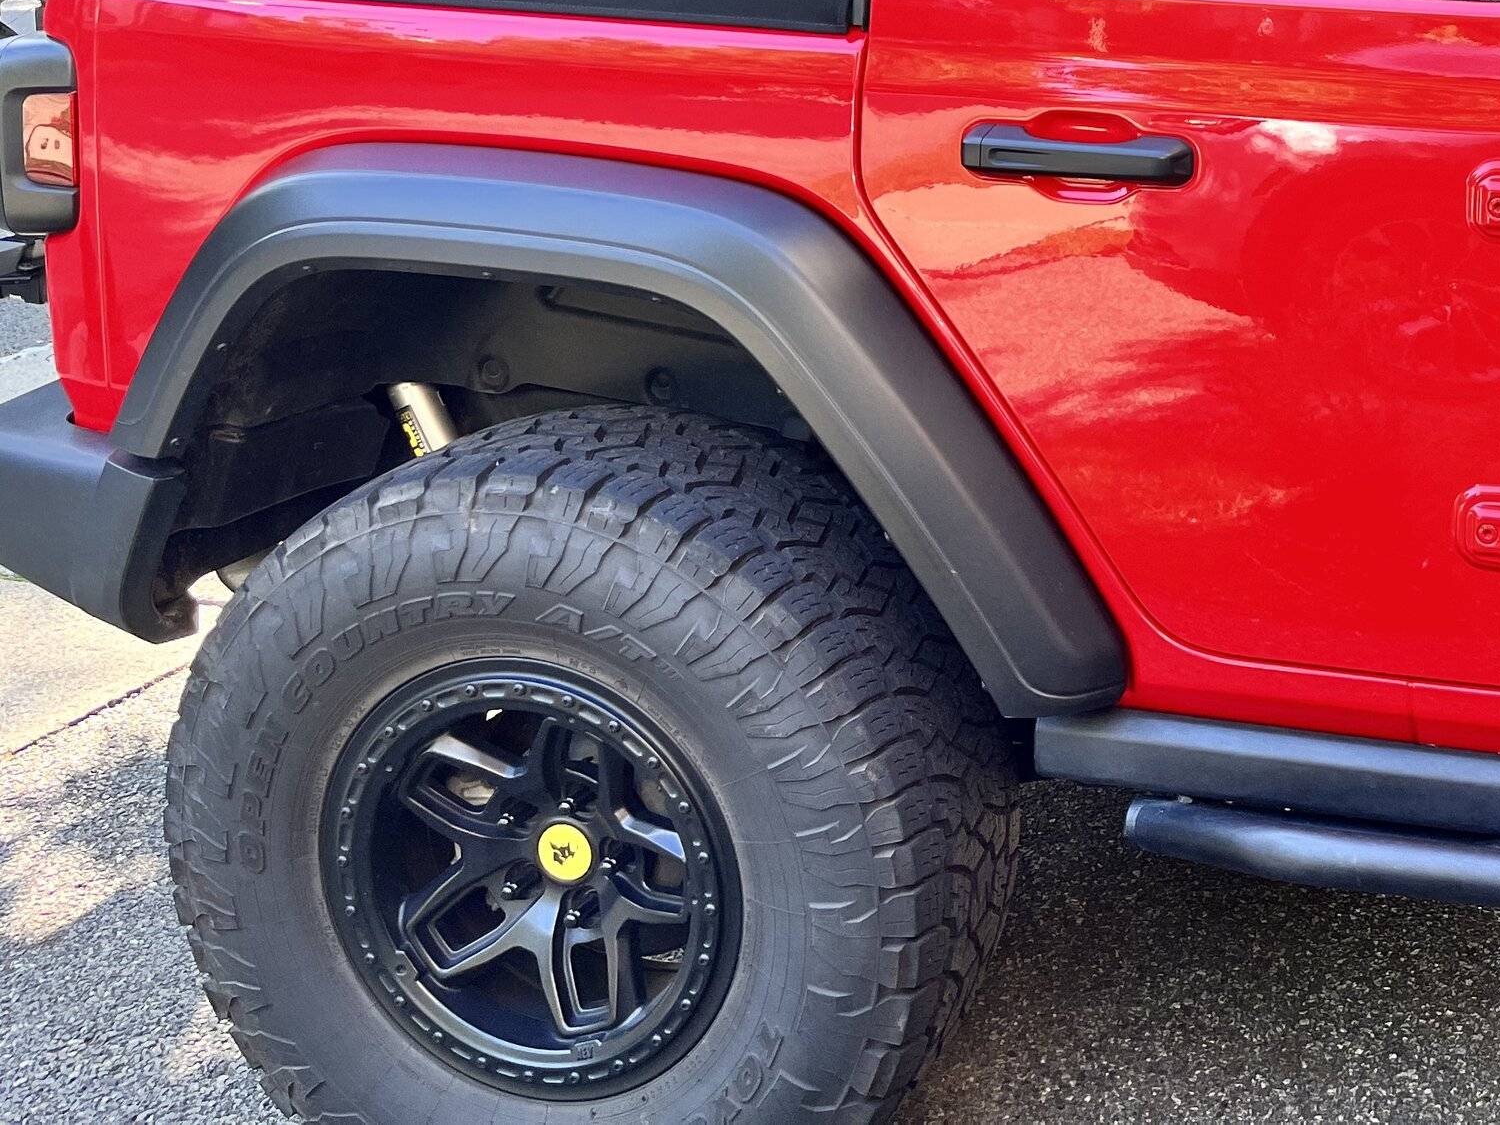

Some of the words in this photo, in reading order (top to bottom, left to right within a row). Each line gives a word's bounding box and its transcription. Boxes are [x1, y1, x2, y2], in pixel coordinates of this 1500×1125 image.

[237, 712, 289, 875] OPEN
[281, 591, 516, 714] COUNTRY
[686, 1015, 785, 1125] TOY
